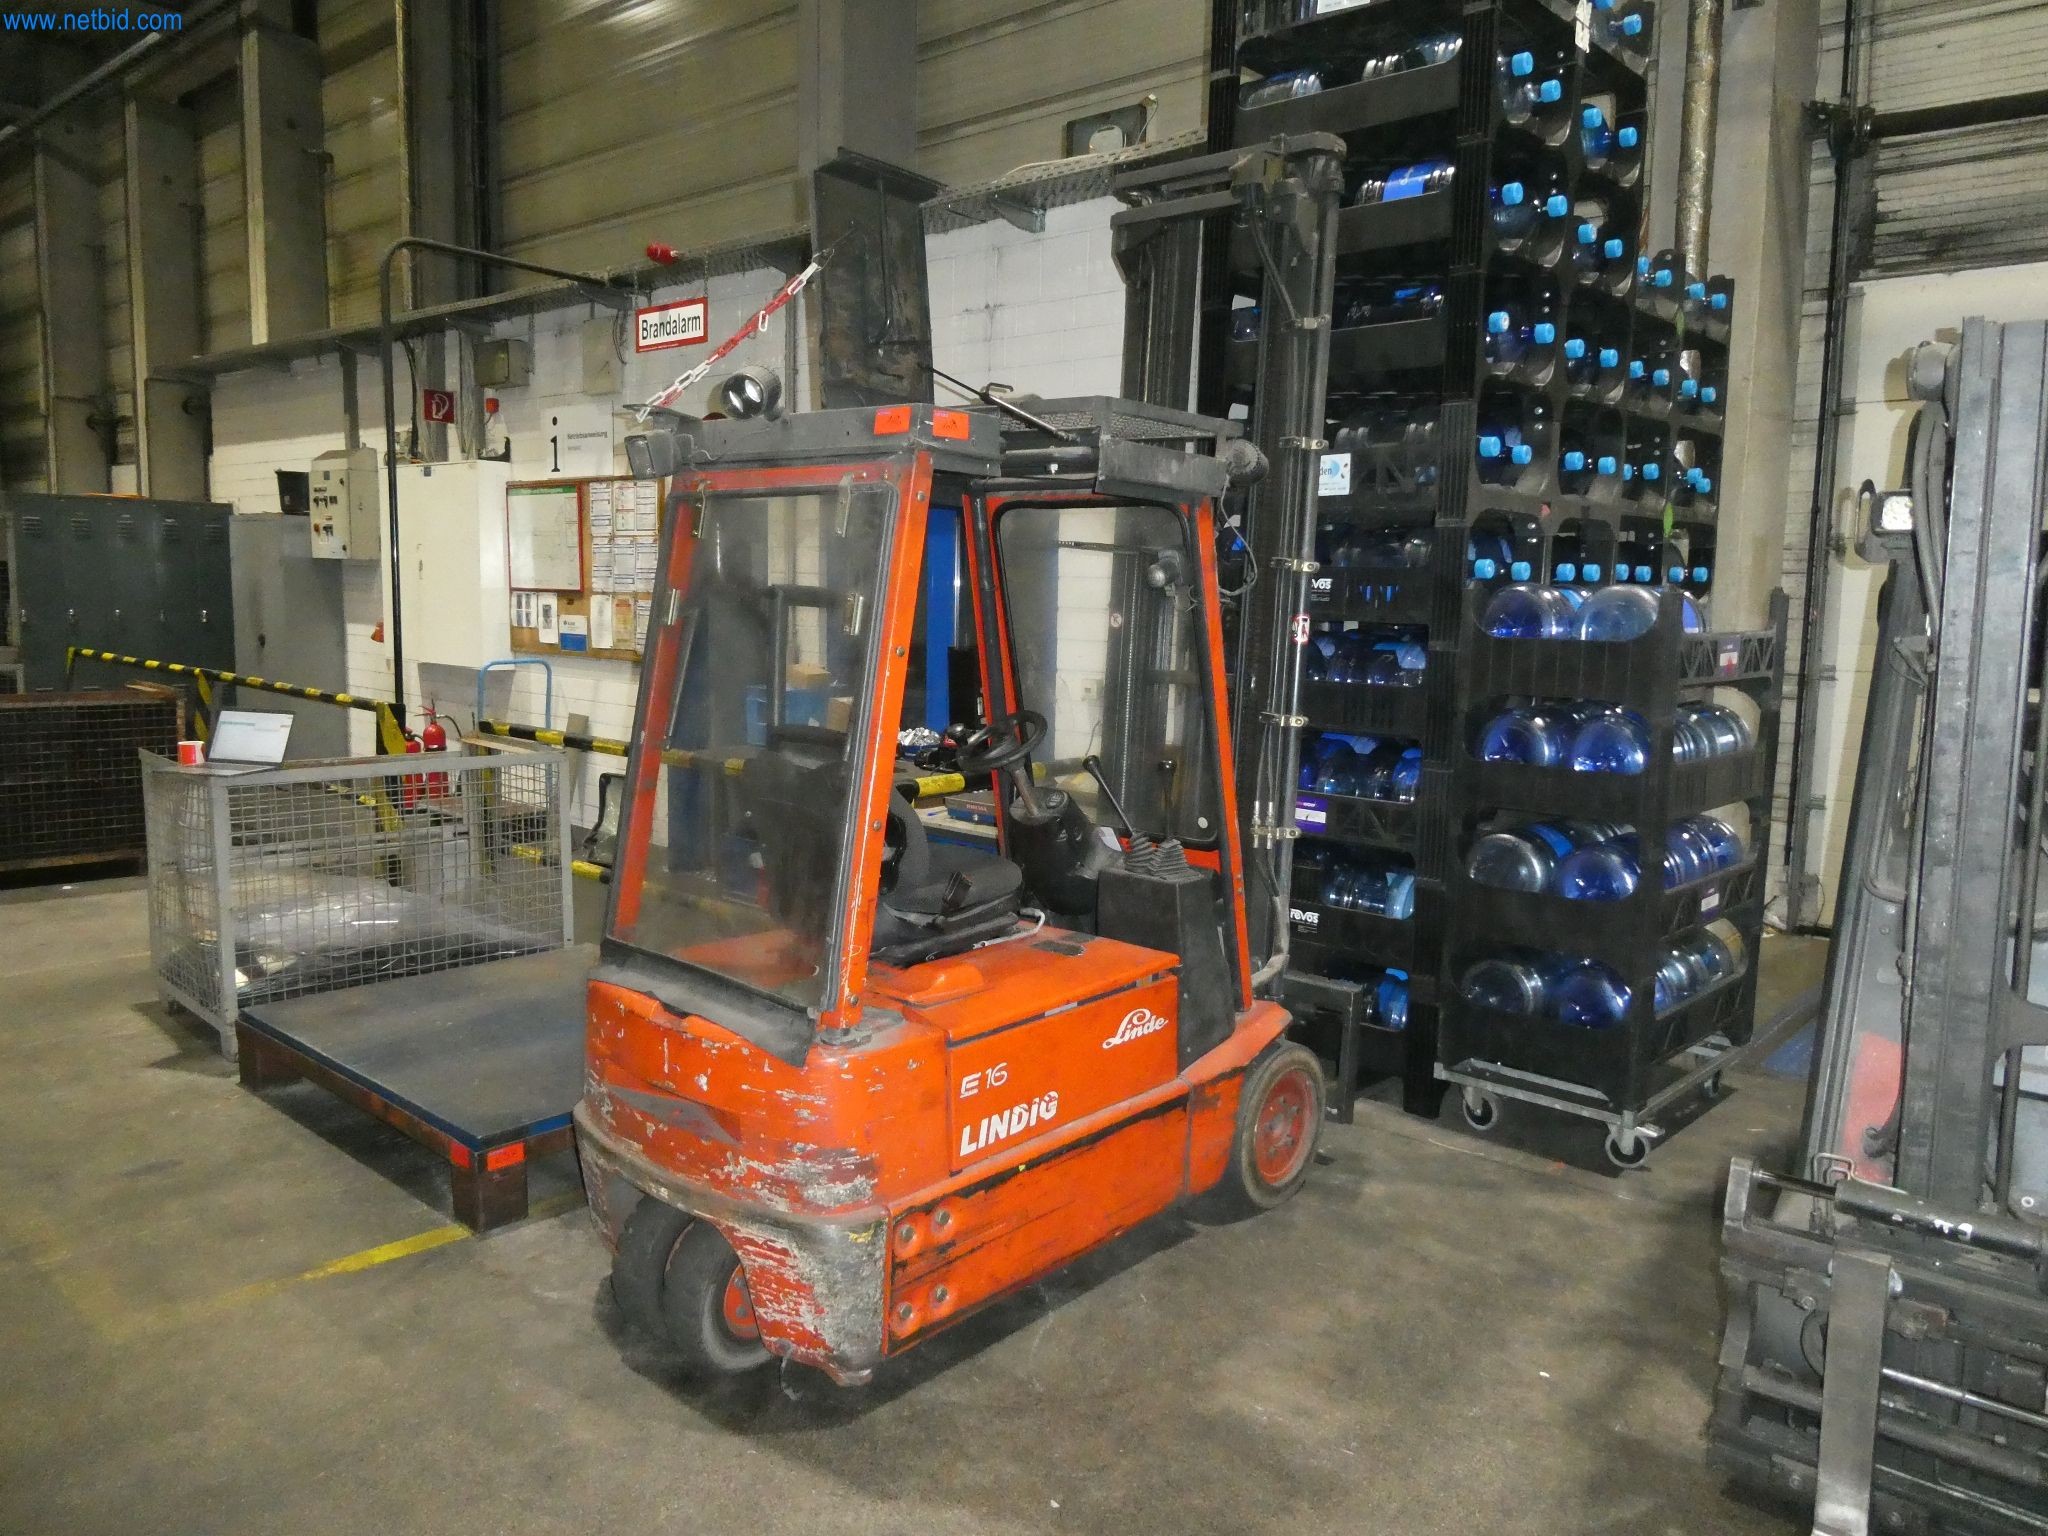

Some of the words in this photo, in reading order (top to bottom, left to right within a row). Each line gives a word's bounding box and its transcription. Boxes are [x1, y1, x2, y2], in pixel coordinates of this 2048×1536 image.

[641, 313, 701, 340] Brandalarm
[1102, 1008, 1169, 1049] Linde
[960, 1072, 981, 1098] E
[985, 1062, 1008, 1089] 16
